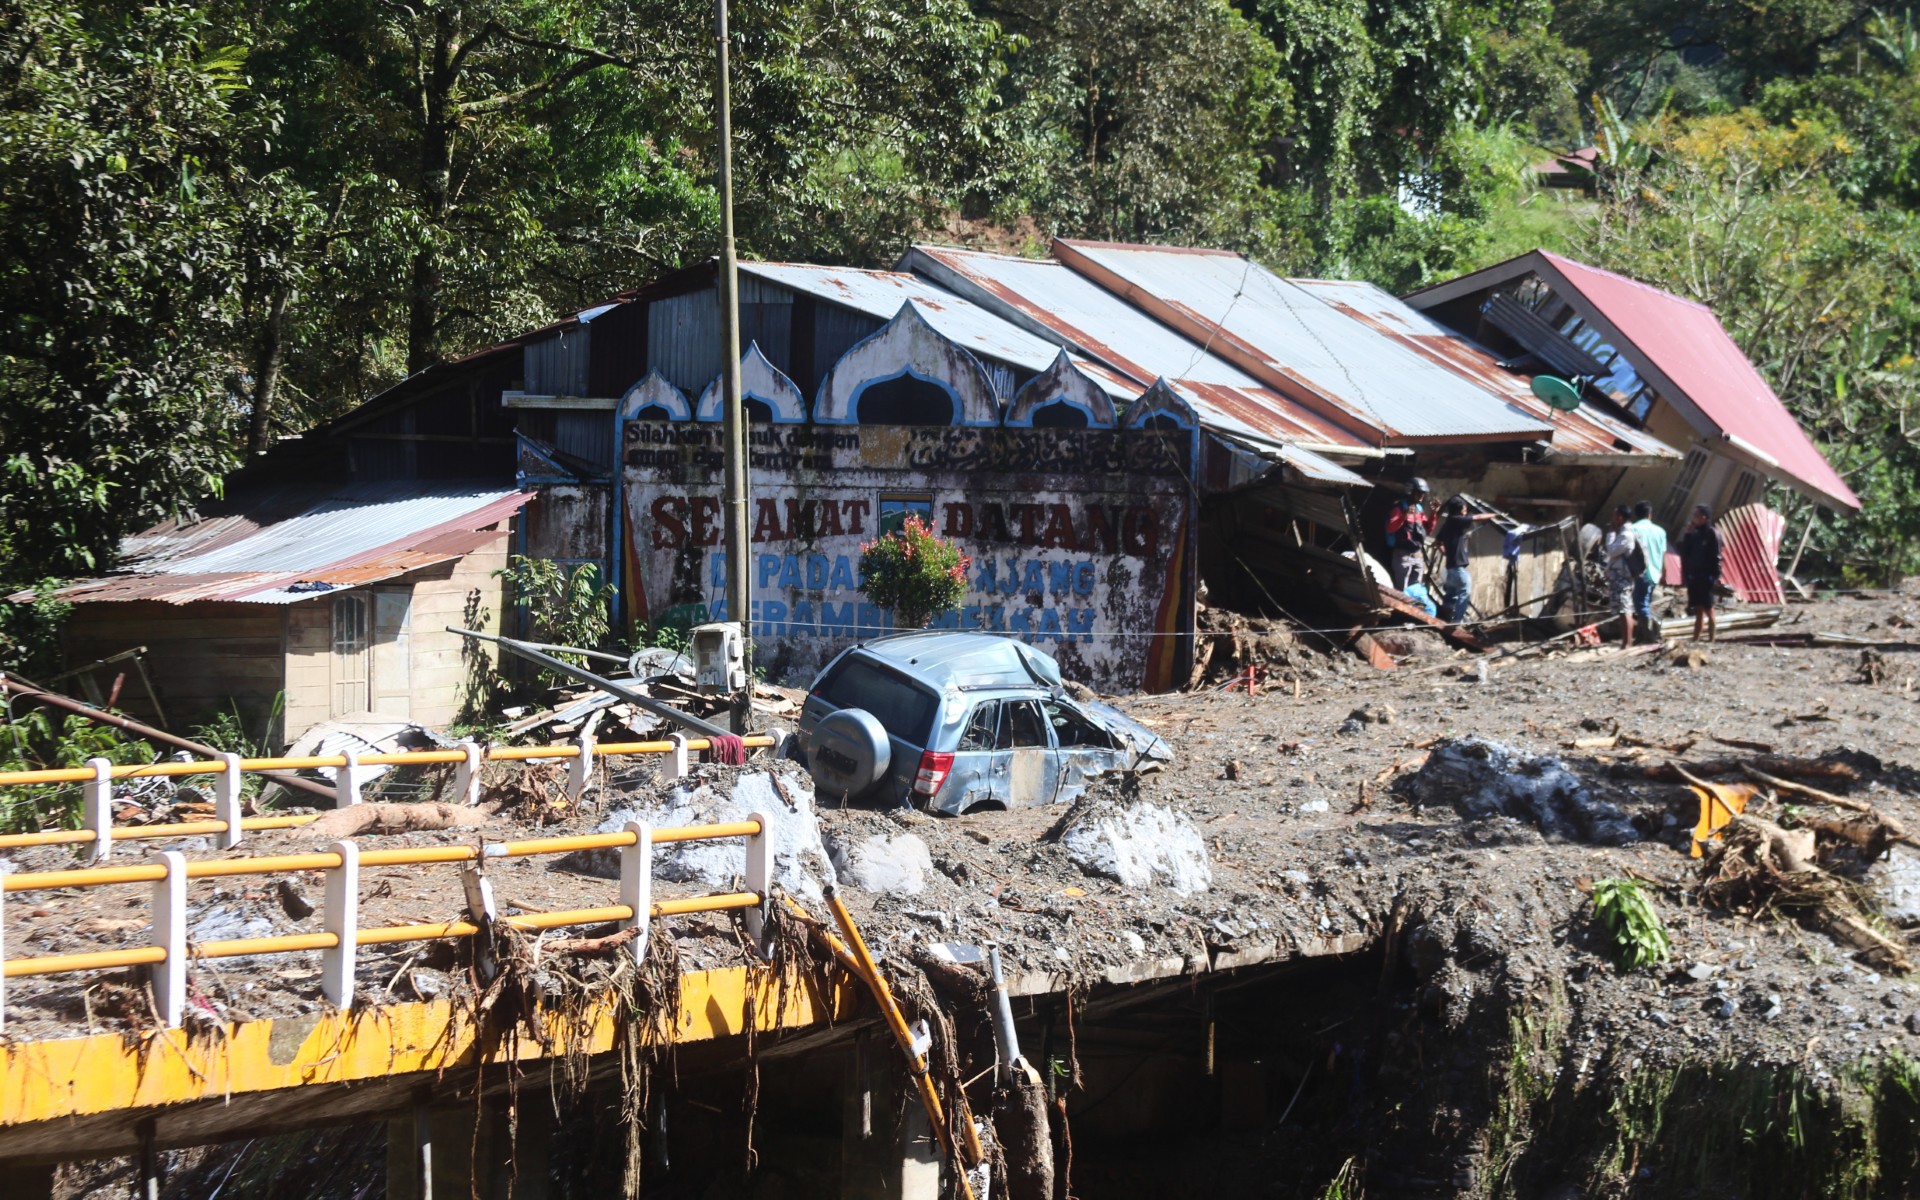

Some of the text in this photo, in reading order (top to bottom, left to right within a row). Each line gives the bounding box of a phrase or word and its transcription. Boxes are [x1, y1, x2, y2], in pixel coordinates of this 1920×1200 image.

[715, 426, 783, 447] suk
[651, 496, 1159, 556] SEAMAT DATANG
[759, 553, 872, 590] PADA
[968, 558, 1095, 597] NJANG
